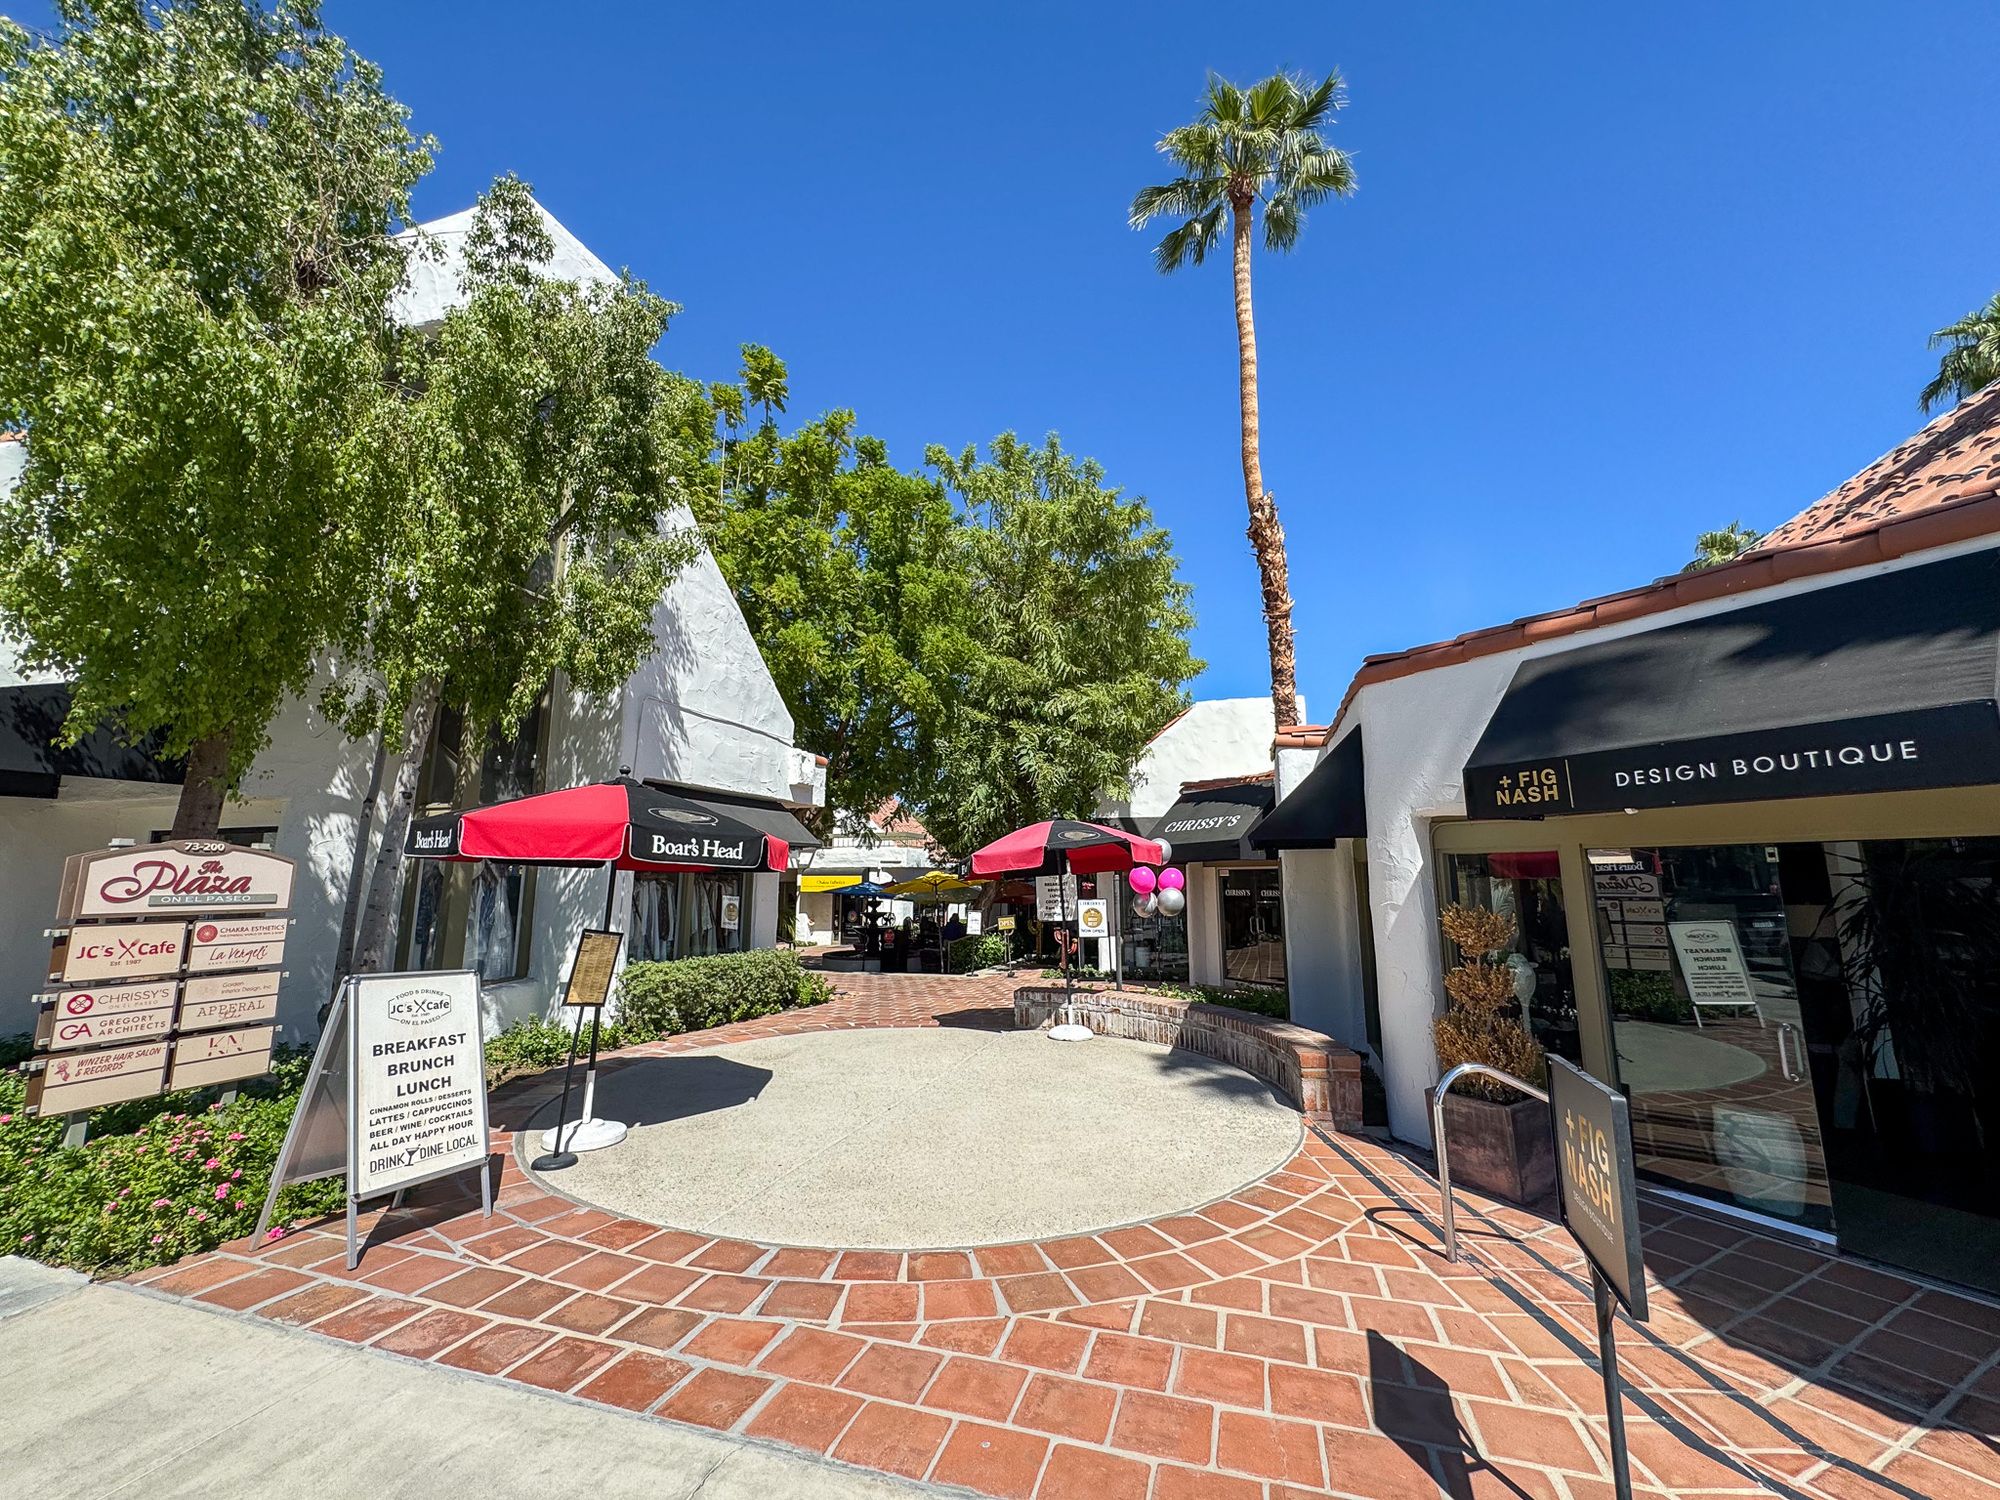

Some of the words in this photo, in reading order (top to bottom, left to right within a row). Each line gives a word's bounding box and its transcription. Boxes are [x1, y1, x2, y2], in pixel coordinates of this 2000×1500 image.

[1615, 761, 1718, 788] DESIGN
[1734, 740, 1918, 776] BOUTIQUE
[1519, 767, 1558, 786] FIG
[1496, 784, 1559, 806] NASH
[1164, 815, 1241, 833] CHRISSY'S
[185, 842, 226, 852] 73-200
[414, 830, 434, 848] Boar's
[434, 828, 452, 848] Head
[651, 835, 699, 857] Boar's
[701, 839, 743, 860] Head
[199, 860, 225, 875] The
[100, 860, 253, 903] Plaza
[76, 945, 114, 959] JC's
[138, 940, 176, 955] Cafe
[210, 948, 226, 960] La
[98, 989, 170, 1005] CHRISSY'S
[395, 990, 414, 1000] FOOD
[196, 1000, 265, 1017] APPERAL
[391, 1004, 413, 1014] JC's
[426, 1000, 450, 1010] Cafe
[98, 1021, 166, 1036] ARCHITECTS
[99, 1014, 154, 1028] GREGORY
[421, 1015, 440, 1025] PASEO
[373, 1033, 466, 1057] BREAKFAST
[77, 1055, 111, 1067] WINZER
[113, 1051, 134, 1061] HAIR
[135, 1047, 162, 1058] SALON
[387, 1055, 454, 1076] BRUNCH
[83, 1062, 125, 1075] RECORDS
[397, 1076, 451, 1097] LUNCH
[370, 1102, 409, 1115] CINNAMON
[411, 1097, 433, 1106] ROLLS
[438, 1089, 472, 1100] DESSERTS
[369, 1113, 405, 1127] LATTES
[412, 1098, 472, 1117] CAPPUCCINOS
[369, 1127, 393, 1139] BEER
[400, 1120, 422, 1131] WINE
[428, 1109, 473, 1125] COCKTAILS
[370, 1141, 389, 1152] ALL
[392, 1134, 412, 1146] DAY
[414, 1126, 445, 1140] HAPPY
[448, 1119, 474, 1132] HOUR
[1578, 1114, 1610, 1177] FIG
[369, 1152, 405, 1174] DRINK
[420, 1142, 444, 1159] DINE
[446, 1134, 478, 1152] LOCAL
[1565, 1139, 1615, 1225] NASH
